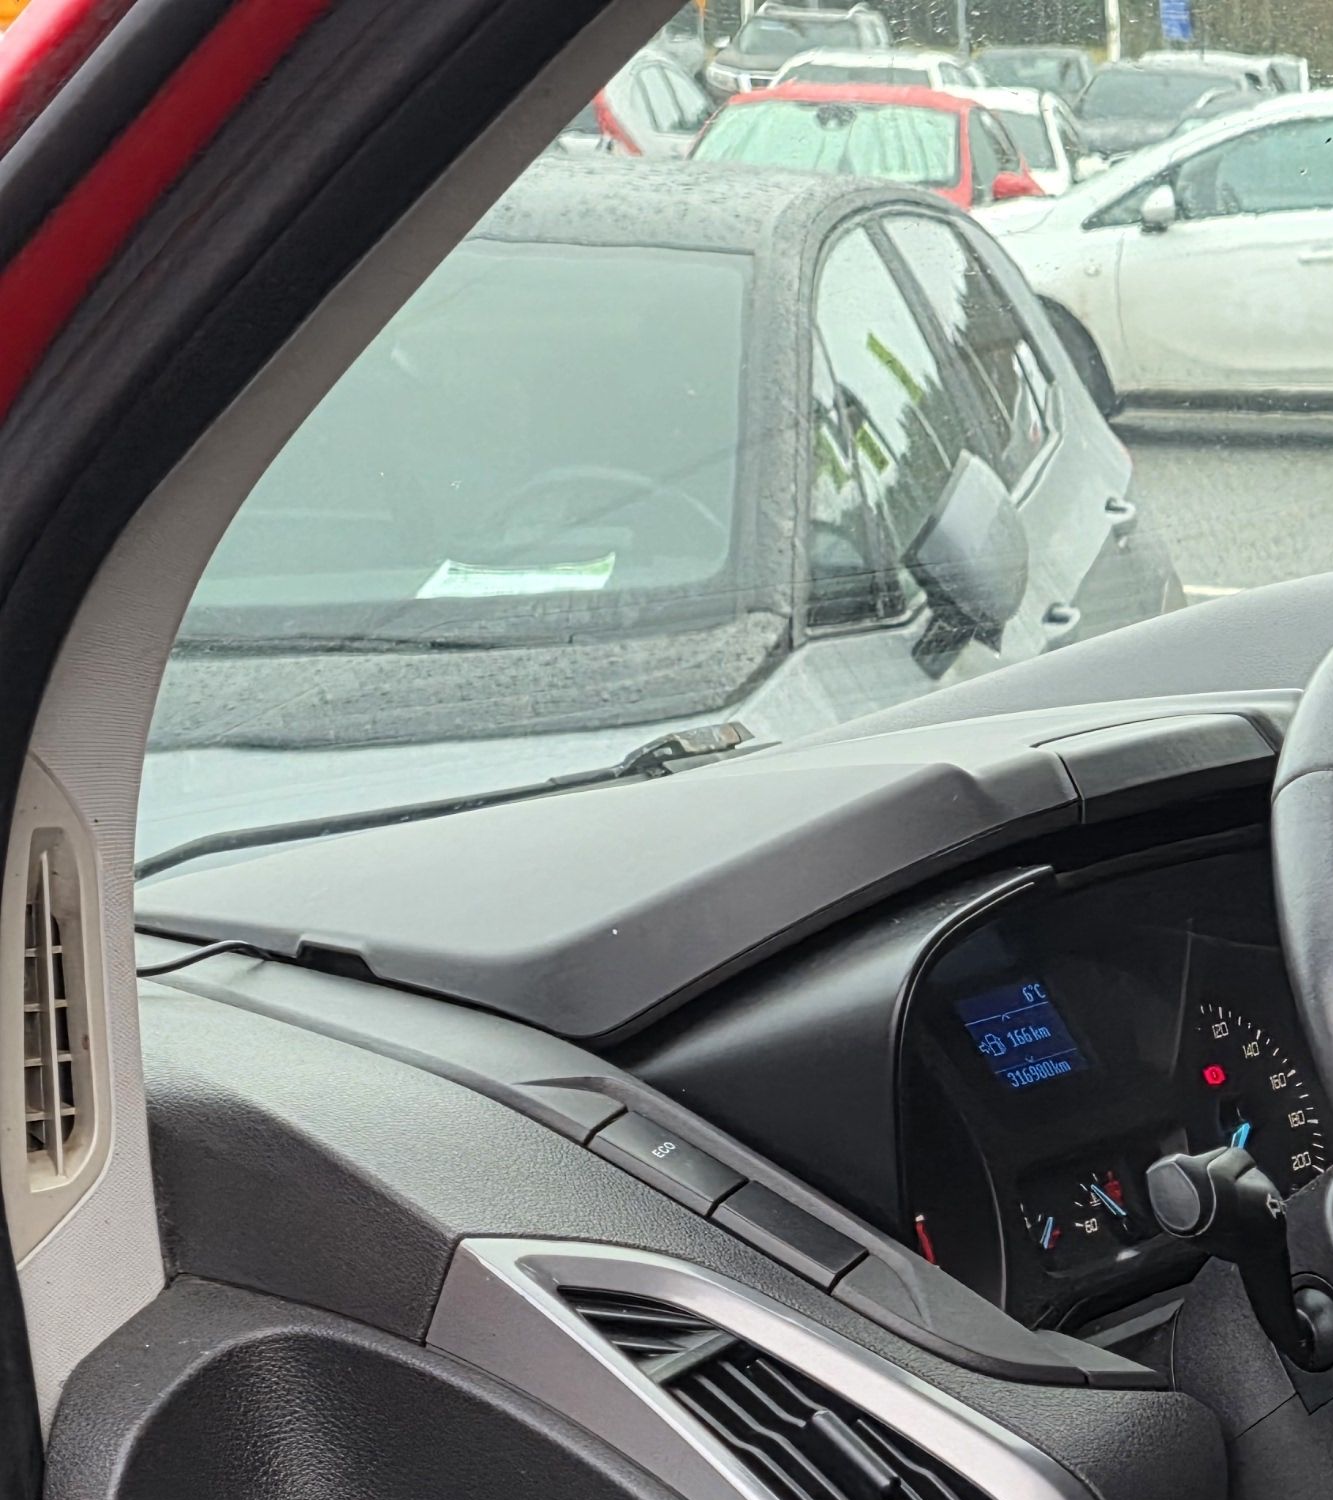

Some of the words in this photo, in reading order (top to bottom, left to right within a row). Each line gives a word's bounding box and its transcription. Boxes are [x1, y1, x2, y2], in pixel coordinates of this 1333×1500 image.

[1022, 983, 1047, 1003] 6°C
[1006, 1026, 1033, 1048] 166
[1028, 1025, 1052, 1041] km
[1212, 1021, 1230, 1039] 120
[1242, 1041, 1260, 1059] 140
[1269, 1072, 1287, 1090] 160
[1288, 1110, 1306, 1128] 180
[651, 1141, 676, 1158] ECO
[1291, 1151, 1312, 1171] 200
